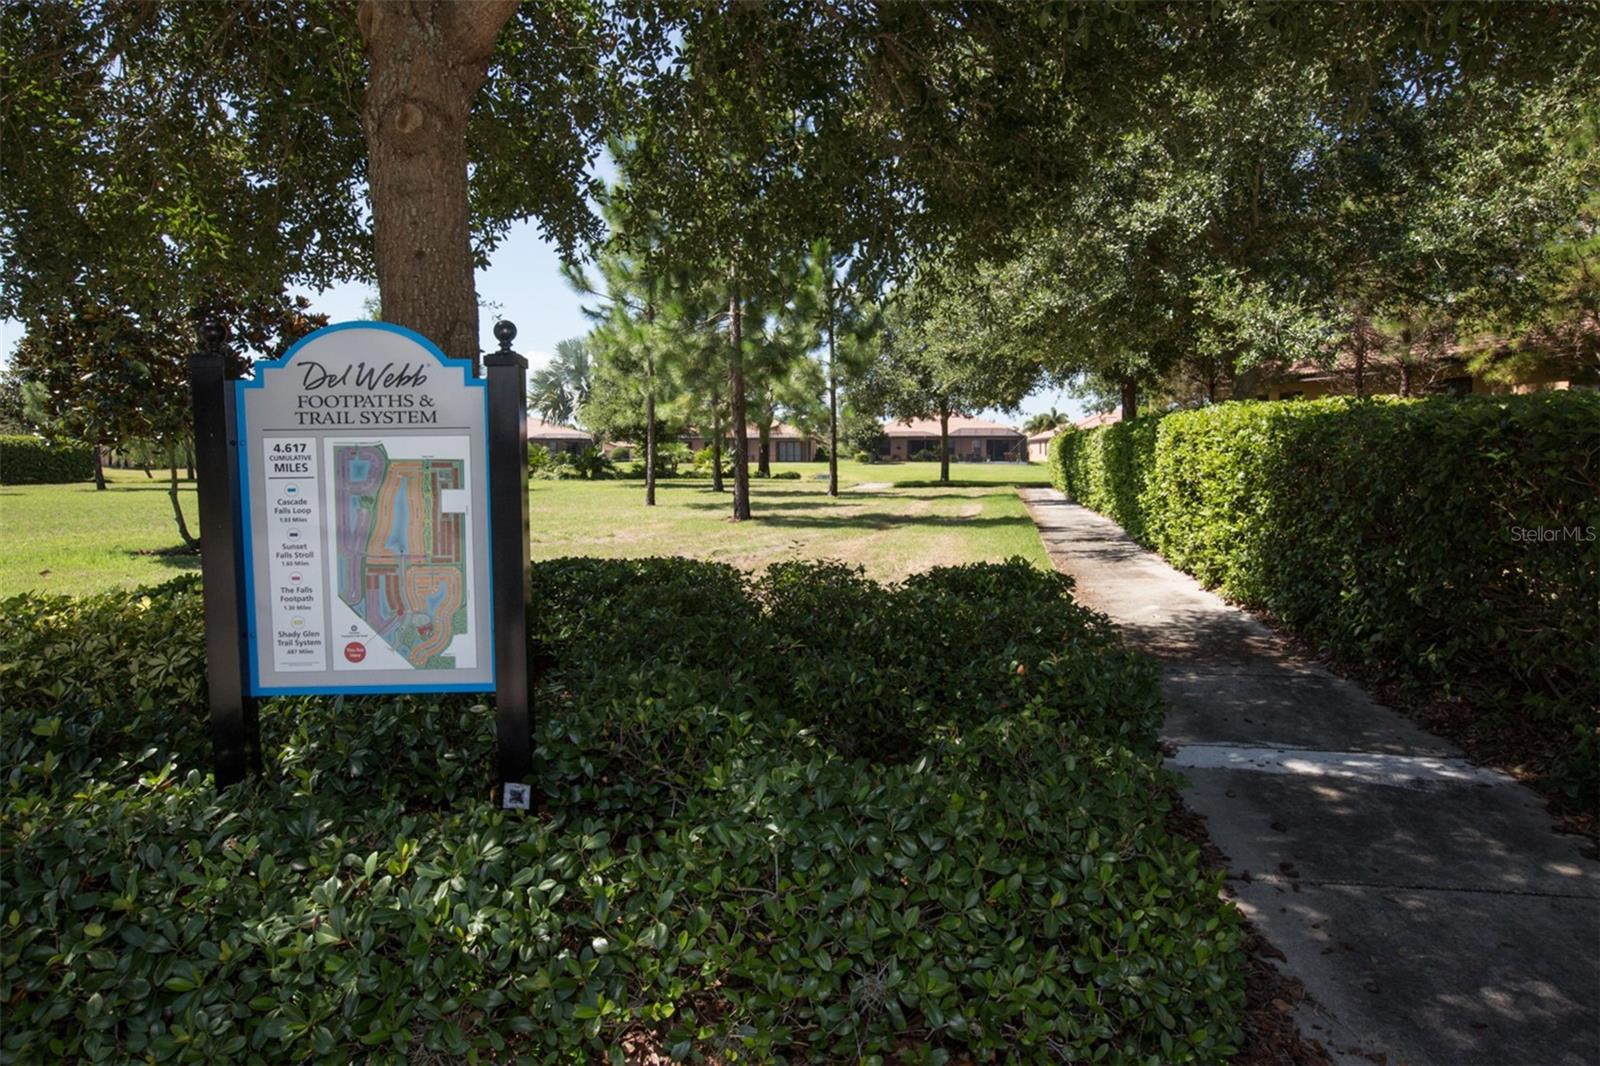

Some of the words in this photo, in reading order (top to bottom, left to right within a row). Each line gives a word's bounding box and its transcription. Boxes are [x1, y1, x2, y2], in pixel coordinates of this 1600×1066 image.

[297, 361, 352, 390] Del
[297, 394, 414, 408] FOOTPATHS
[419, 394, 435, 408] &
[294, 411, 355, 425] TRAIL
[359, 410, 438, 424] SYSTEM
[273, 443, 307, 453] 4.617
[274, 463, 309, 472] MILES
[277, 498, 308, 506] Cascade
[292, 507, 312, 516] Loop
[276, 551, 293, 559] Falls
[294, 551, 314, 559] Stroll
[280, 586, 294, 594] The
[296, 586, 313, 594] Falls
[280, 595, 314, 603] Footpath
[278, 630, 301, 640] Shady
[302, 630, 320, 638] Glen
[294, 639, 322, 648] System
